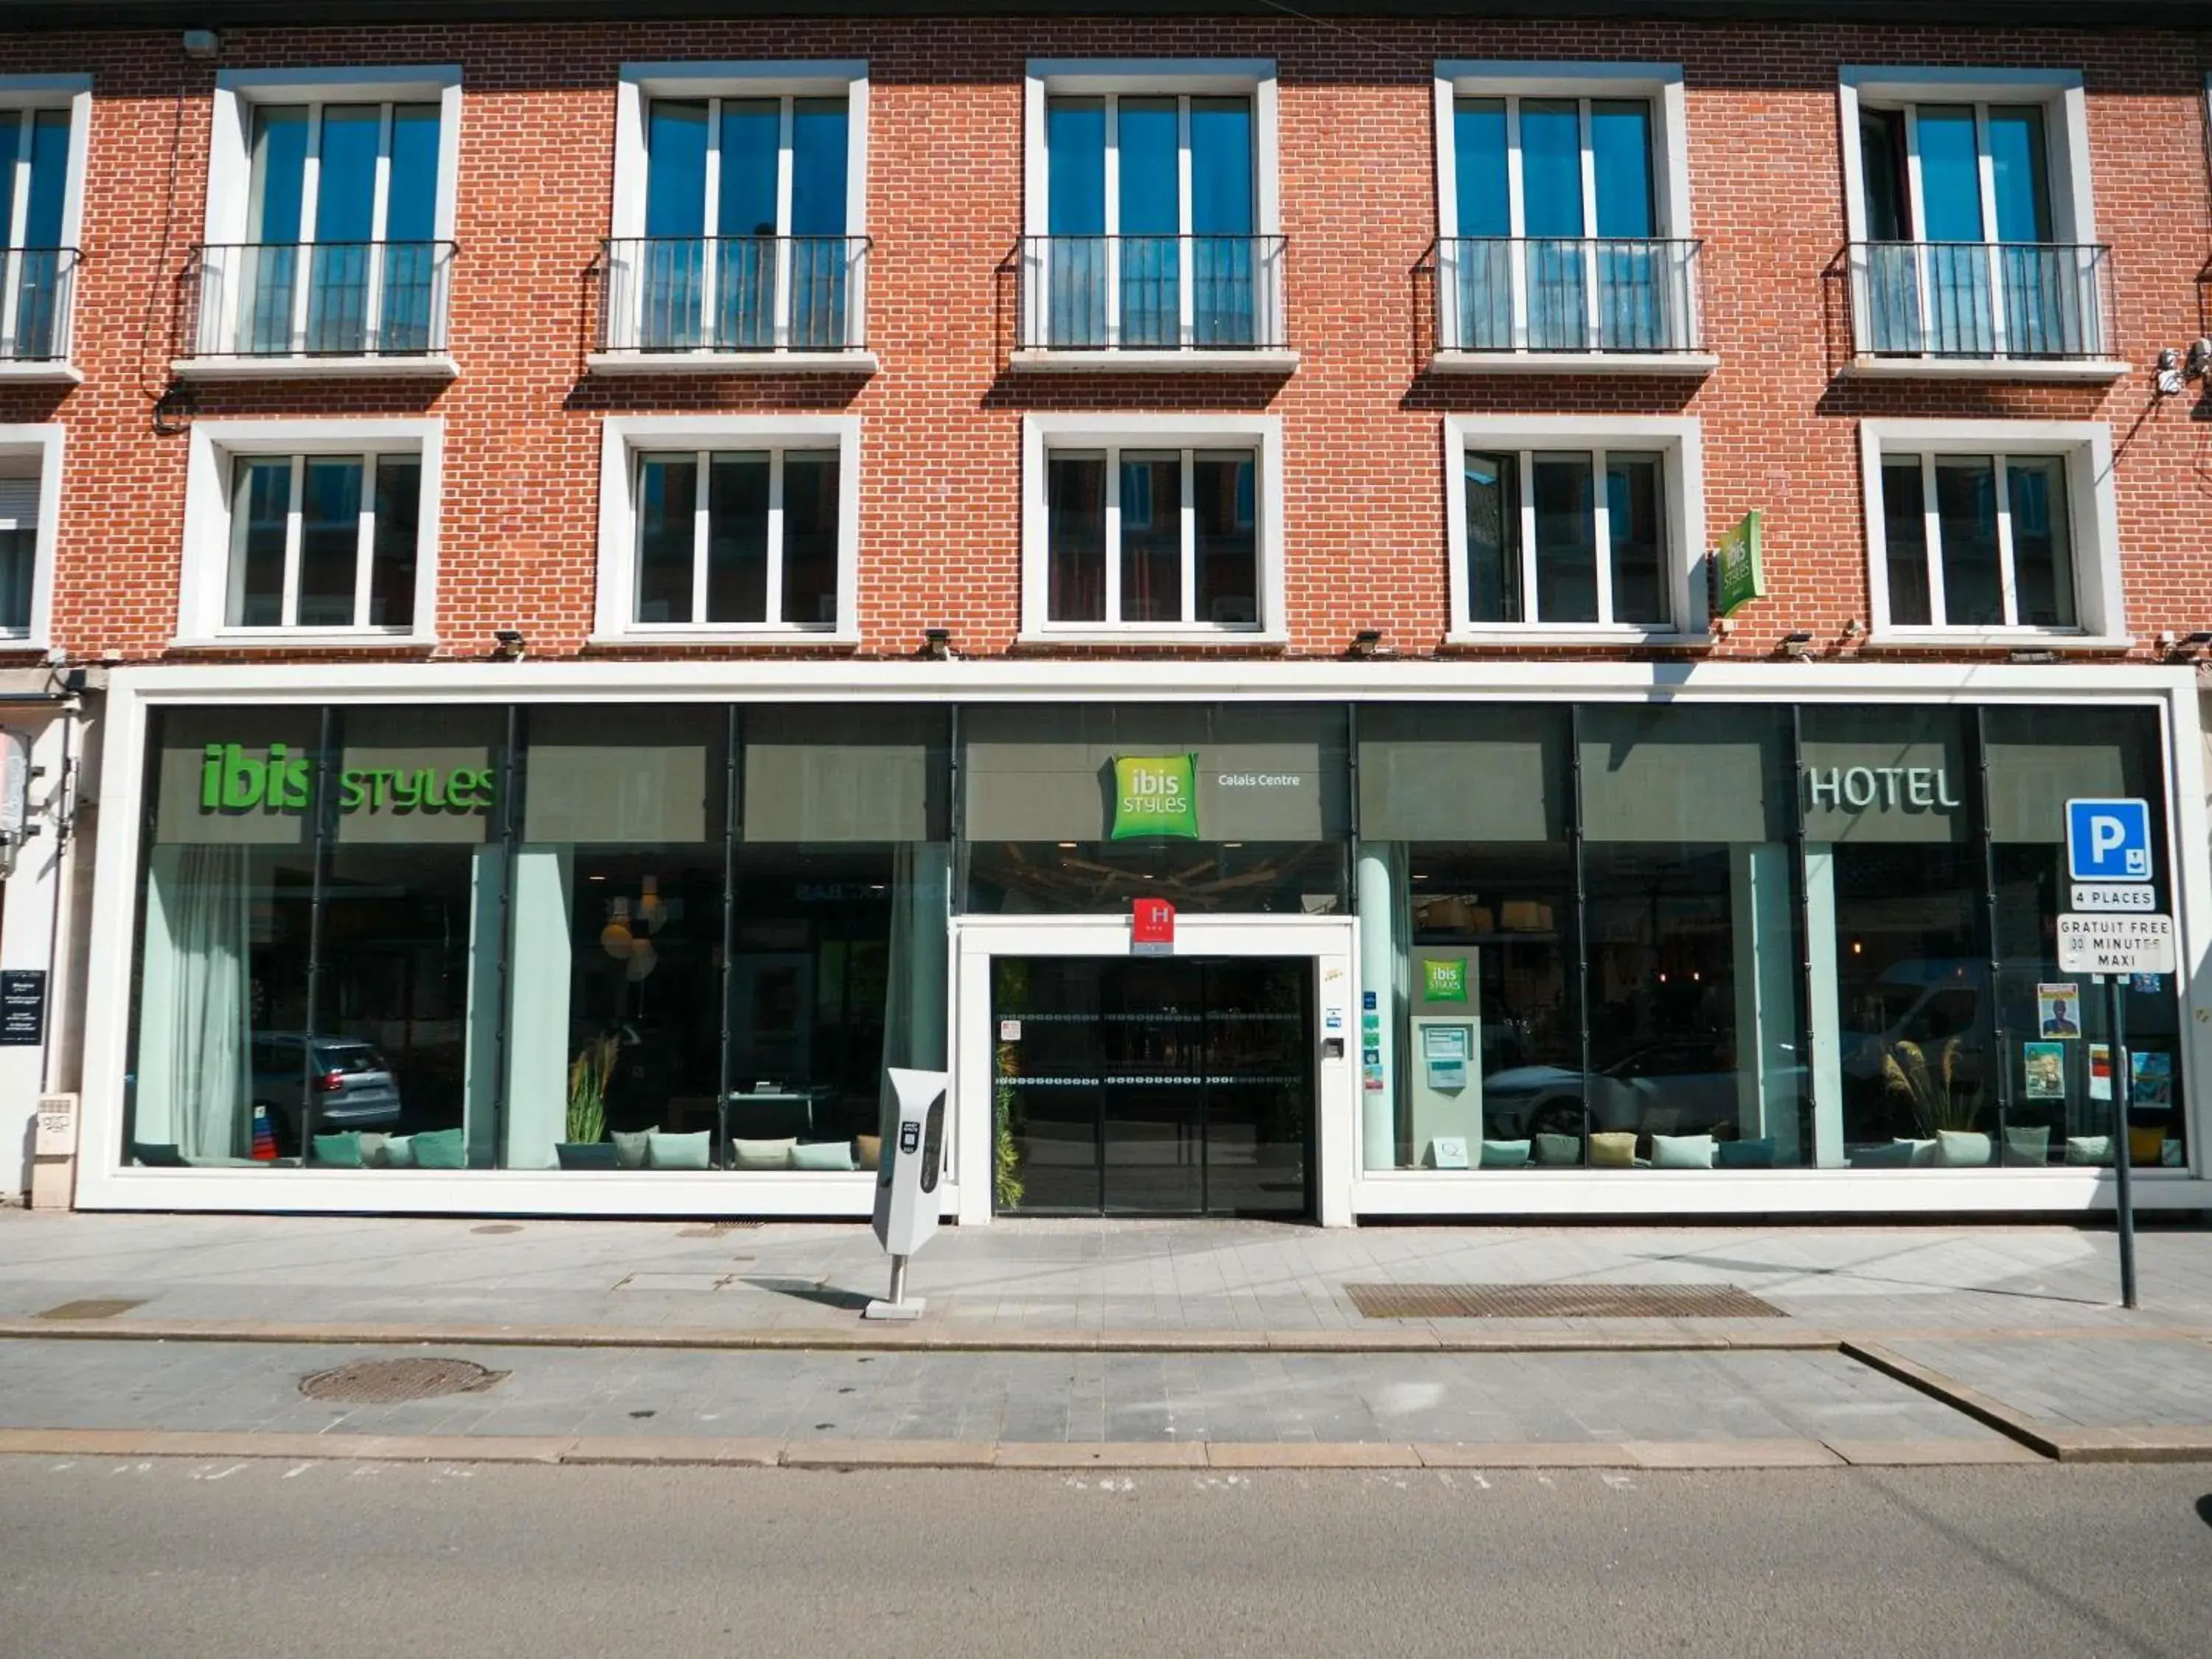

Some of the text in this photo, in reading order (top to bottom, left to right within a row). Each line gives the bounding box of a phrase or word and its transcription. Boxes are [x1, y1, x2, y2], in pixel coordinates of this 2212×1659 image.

[202, 743, 310, 807] ibis
[1133, 769, 1179, 795] ibis
[1219, 773, 1301, 786] Calais Centre
[1810, 766, 1961, 807] HOTEL
[2091, 815, 2126, 863] P
[2076, 891, 2152, 904] 4 PLACES
[1152, 907, 1169, 922] H
[2061, 921, 2169, 934] GRATUIT FREE
[2098, 955, 2135, 967] MAXI
